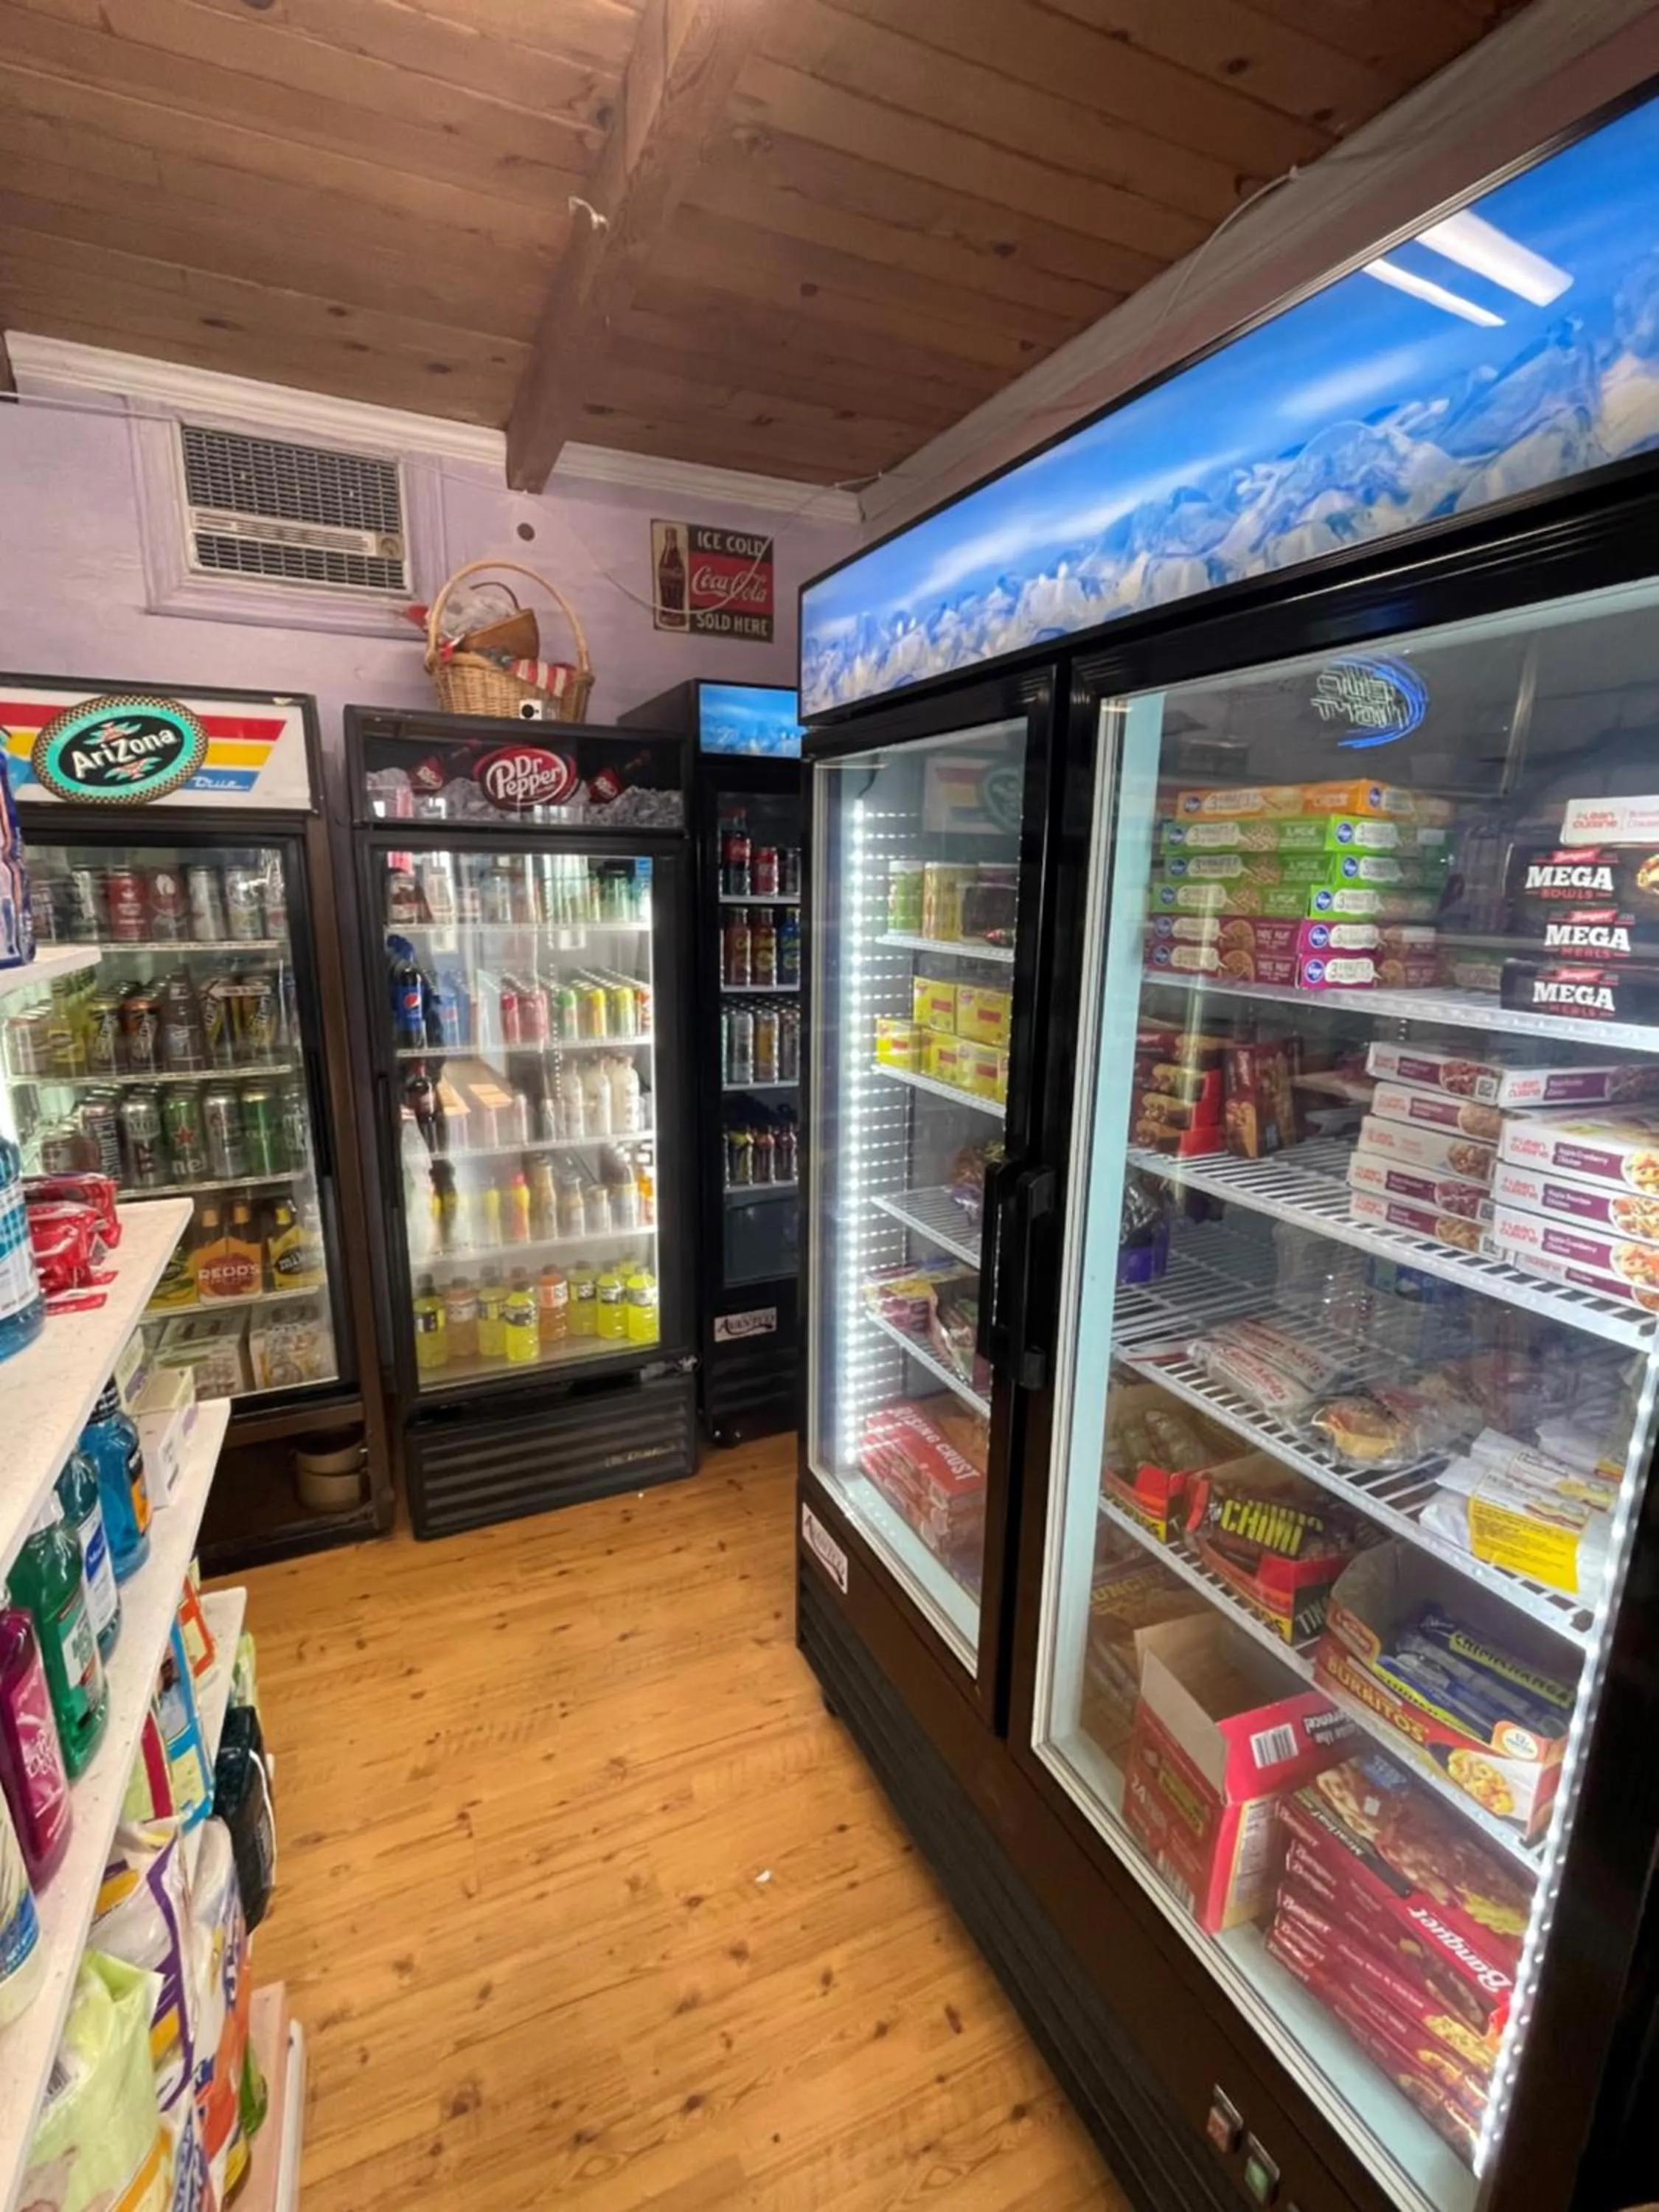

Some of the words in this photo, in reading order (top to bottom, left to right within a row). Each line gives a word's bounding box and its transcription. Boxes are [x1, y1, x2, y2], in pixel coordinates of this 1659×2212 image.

[698, 530, 722, 550] ICE
[726, 535, 765, 557] COLD
[696, 611, 731, 631] SOLD
[734, 615, 768, 636] HERE
[72, 727, 177, 779] AriZona
[515, 755, 543, 778] Dr
[490, 759, 561, 800] Pepper
[1524, 865, 1615, 891] MEGA
[1543, 923, 1631, 953] MEGA
[1532, 981, 1615, 1012] MEGA
[198, 1263, 260, 1281] REDD'S
[935, 1442, 981, 1481] CRUST
[1327, 1653, 1425, 1742] BURRITOS
[1407, 1905, 1512, 1993] Banquet
